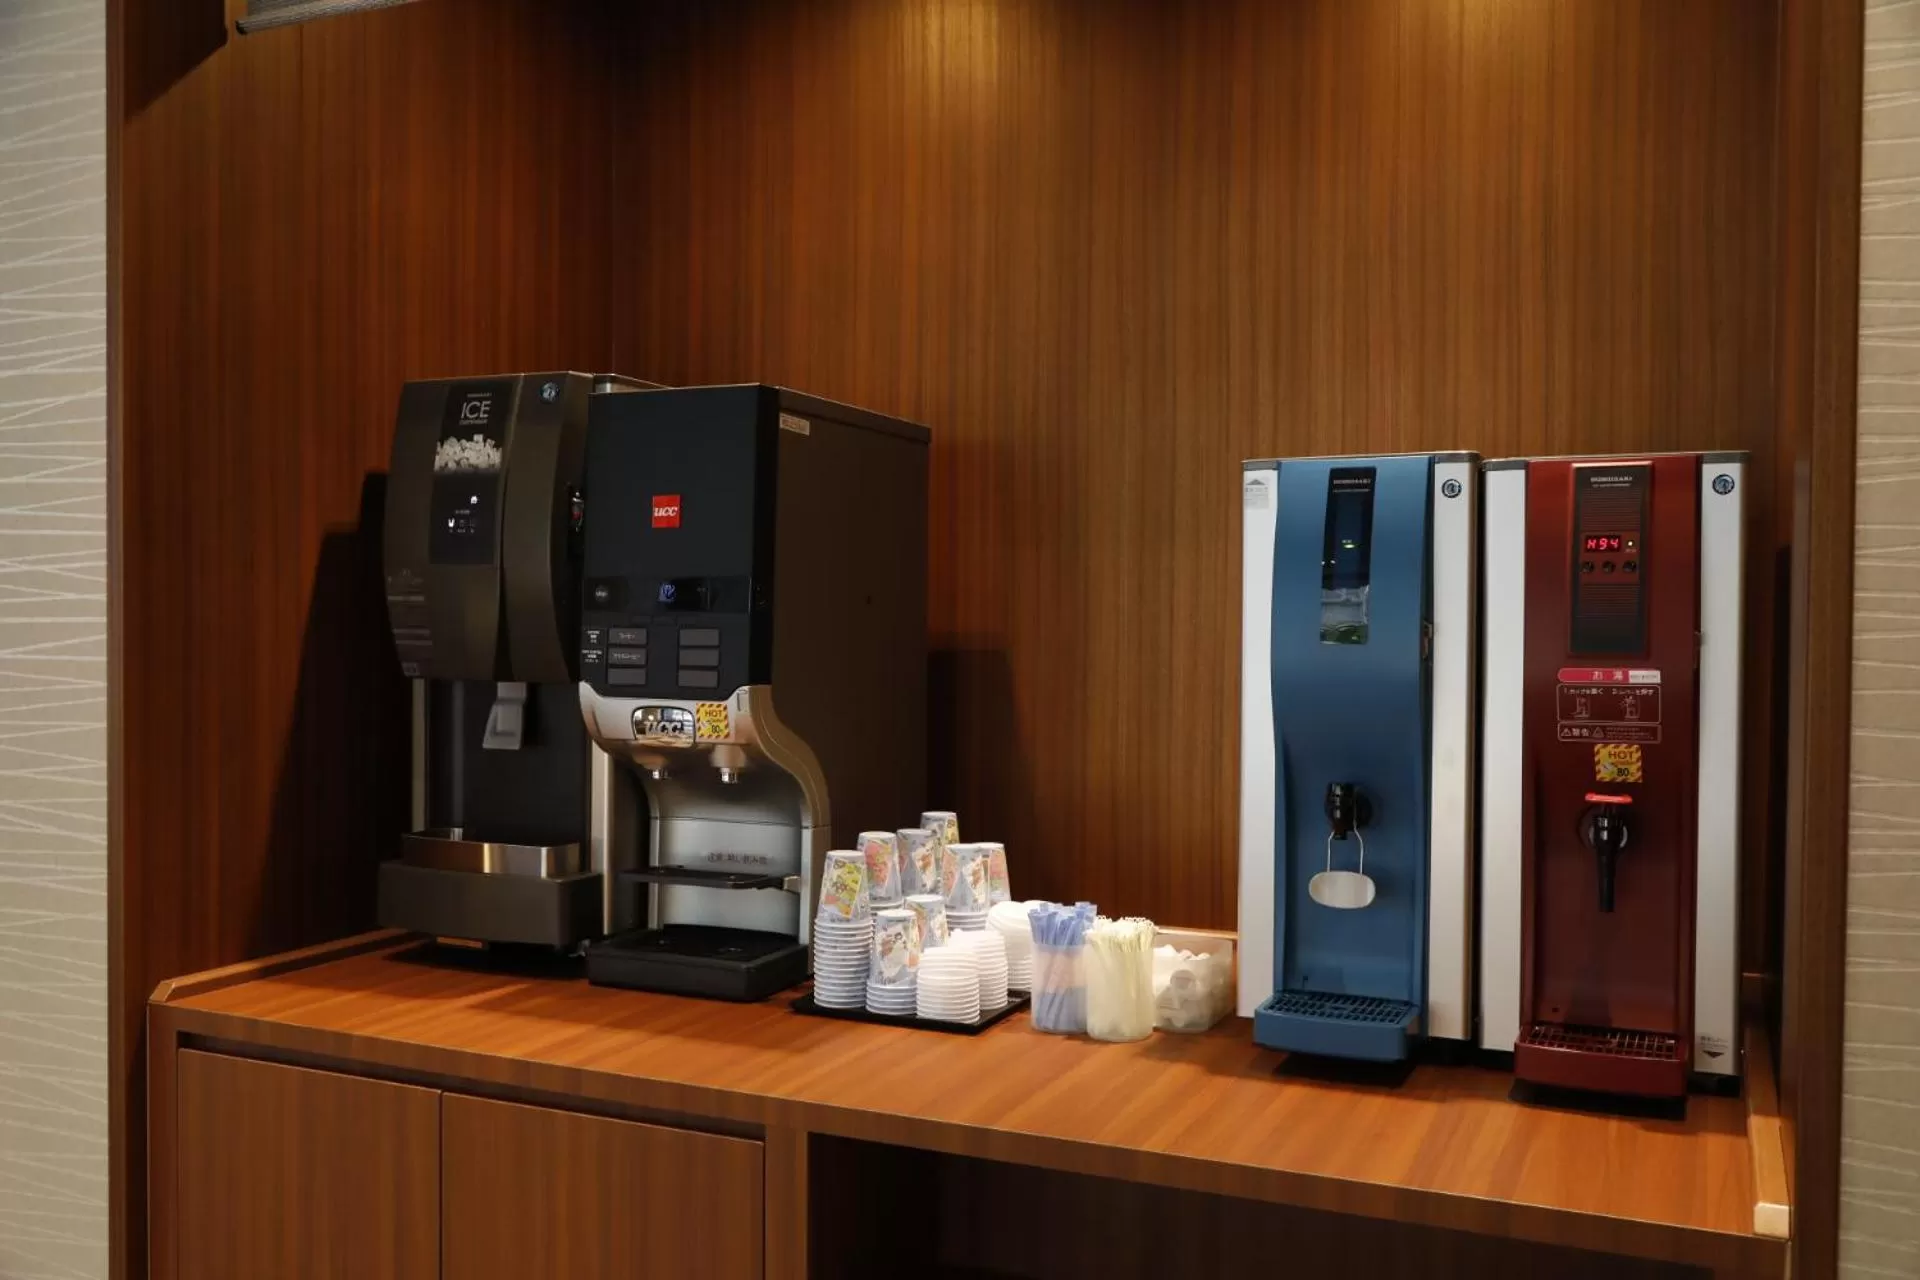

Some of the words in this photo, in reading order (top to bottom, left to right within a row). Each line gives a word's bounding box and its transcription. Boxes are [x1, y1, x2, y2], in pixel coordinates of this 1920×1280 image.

[460, 400, 492, 419] ICE
[704, 709, 723, 718] HOT
[1608, 750, 1633, 760] HOT
